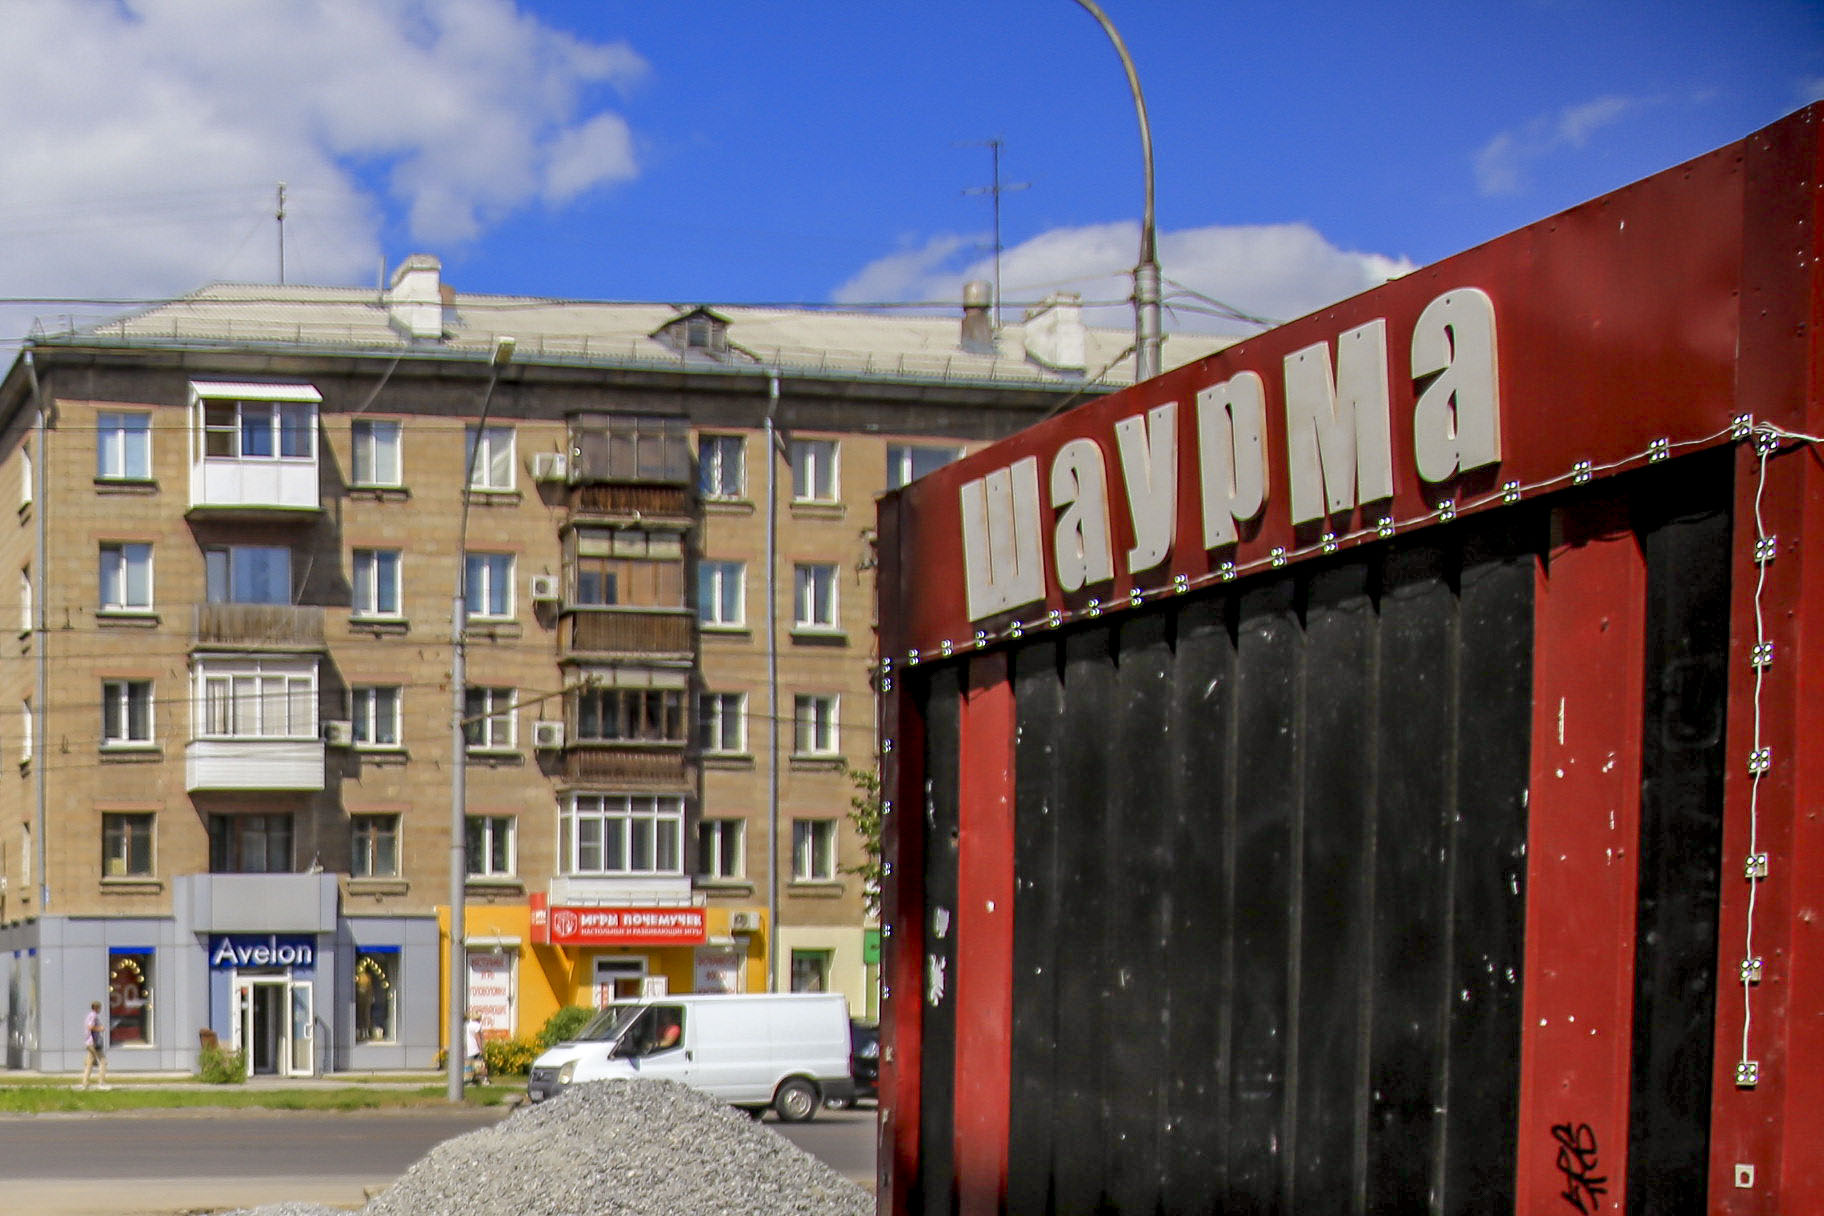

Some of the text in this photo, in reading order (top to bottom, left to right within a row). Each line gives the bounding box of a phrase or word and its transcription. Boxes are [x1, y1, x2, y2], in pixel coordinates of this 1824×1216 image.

[581, 913, 702, 927] ИГРЫ ПОЧЕМУЧЕК
[214, 935, 312, 965] Avelon
